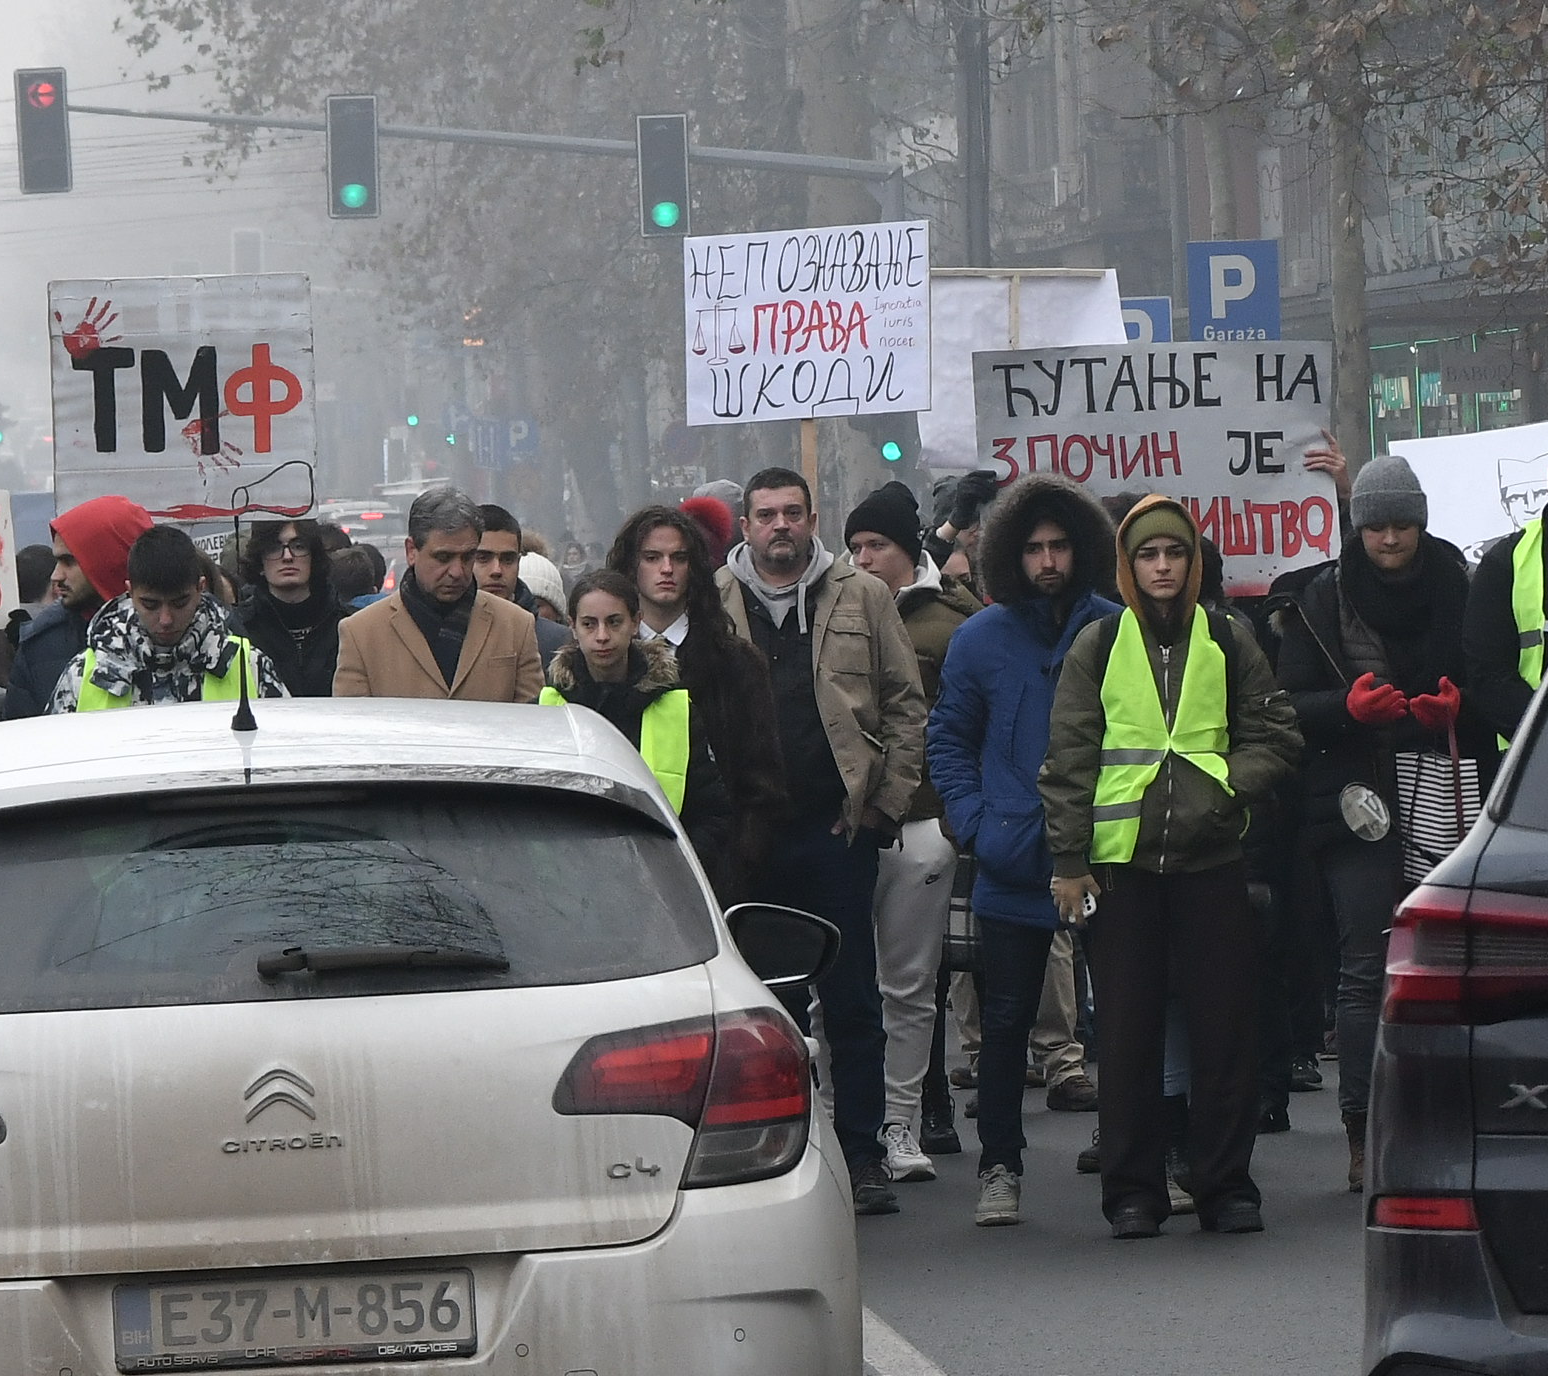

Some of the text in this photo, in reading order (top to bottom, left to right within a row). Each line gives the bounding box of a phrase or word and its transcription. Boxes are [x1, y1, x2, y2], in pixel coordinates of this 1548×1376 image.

[752, 299, 873, 356] ПРАВА
[70, 342, 304, 456] ТМФ
[709, 351, 905, 419] ШКОДИ
[1255, 353, 1323, 405] НА
[1226, 430, 1286, 476] ЈЕ
[120, 1329, 151, 1346] BIH
[159, 1281, 461, 1348] E37-M-856
[136, 1357, 172, 1368] AUTO
[173, 1354, 219, 1367] SERVIS
